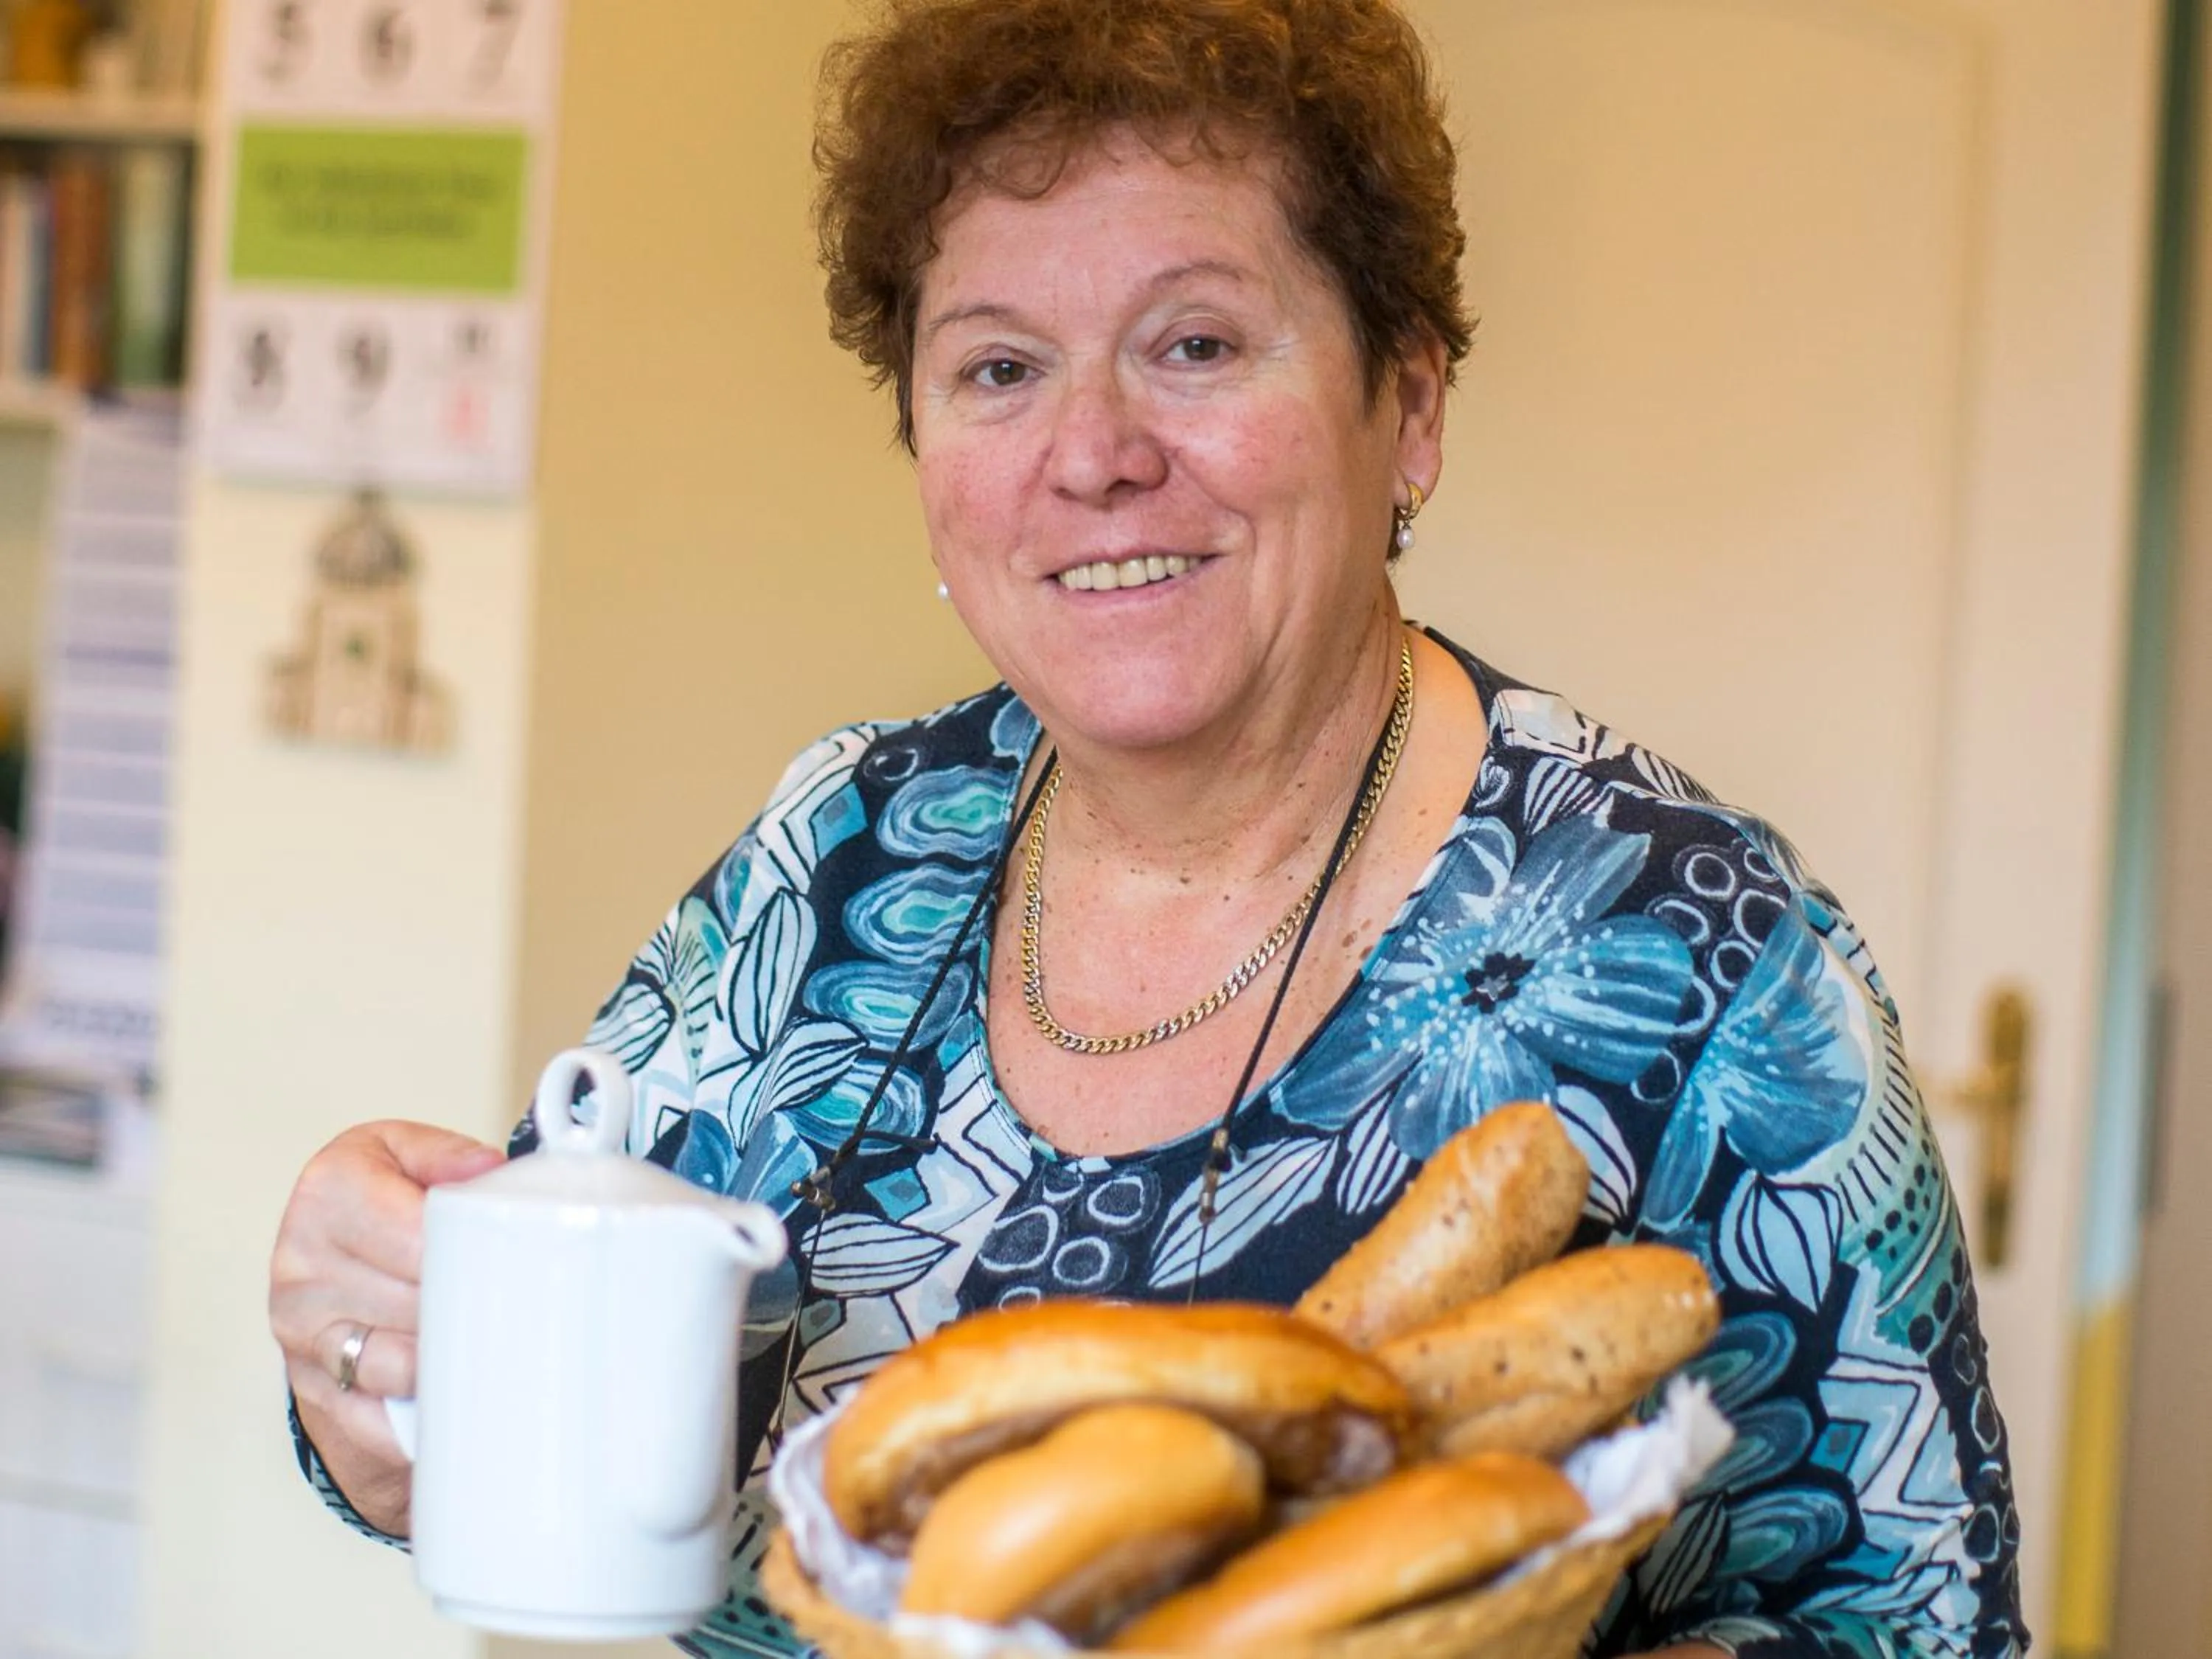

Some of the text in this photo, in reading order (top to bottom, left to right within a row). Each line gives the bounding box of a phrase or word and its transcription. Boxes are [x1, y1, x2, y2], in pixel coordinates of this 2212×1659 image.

[357, 0, 417, 87] 6
[466, 0, 525, 94] 7
[336, 317, 394, 422] 9
